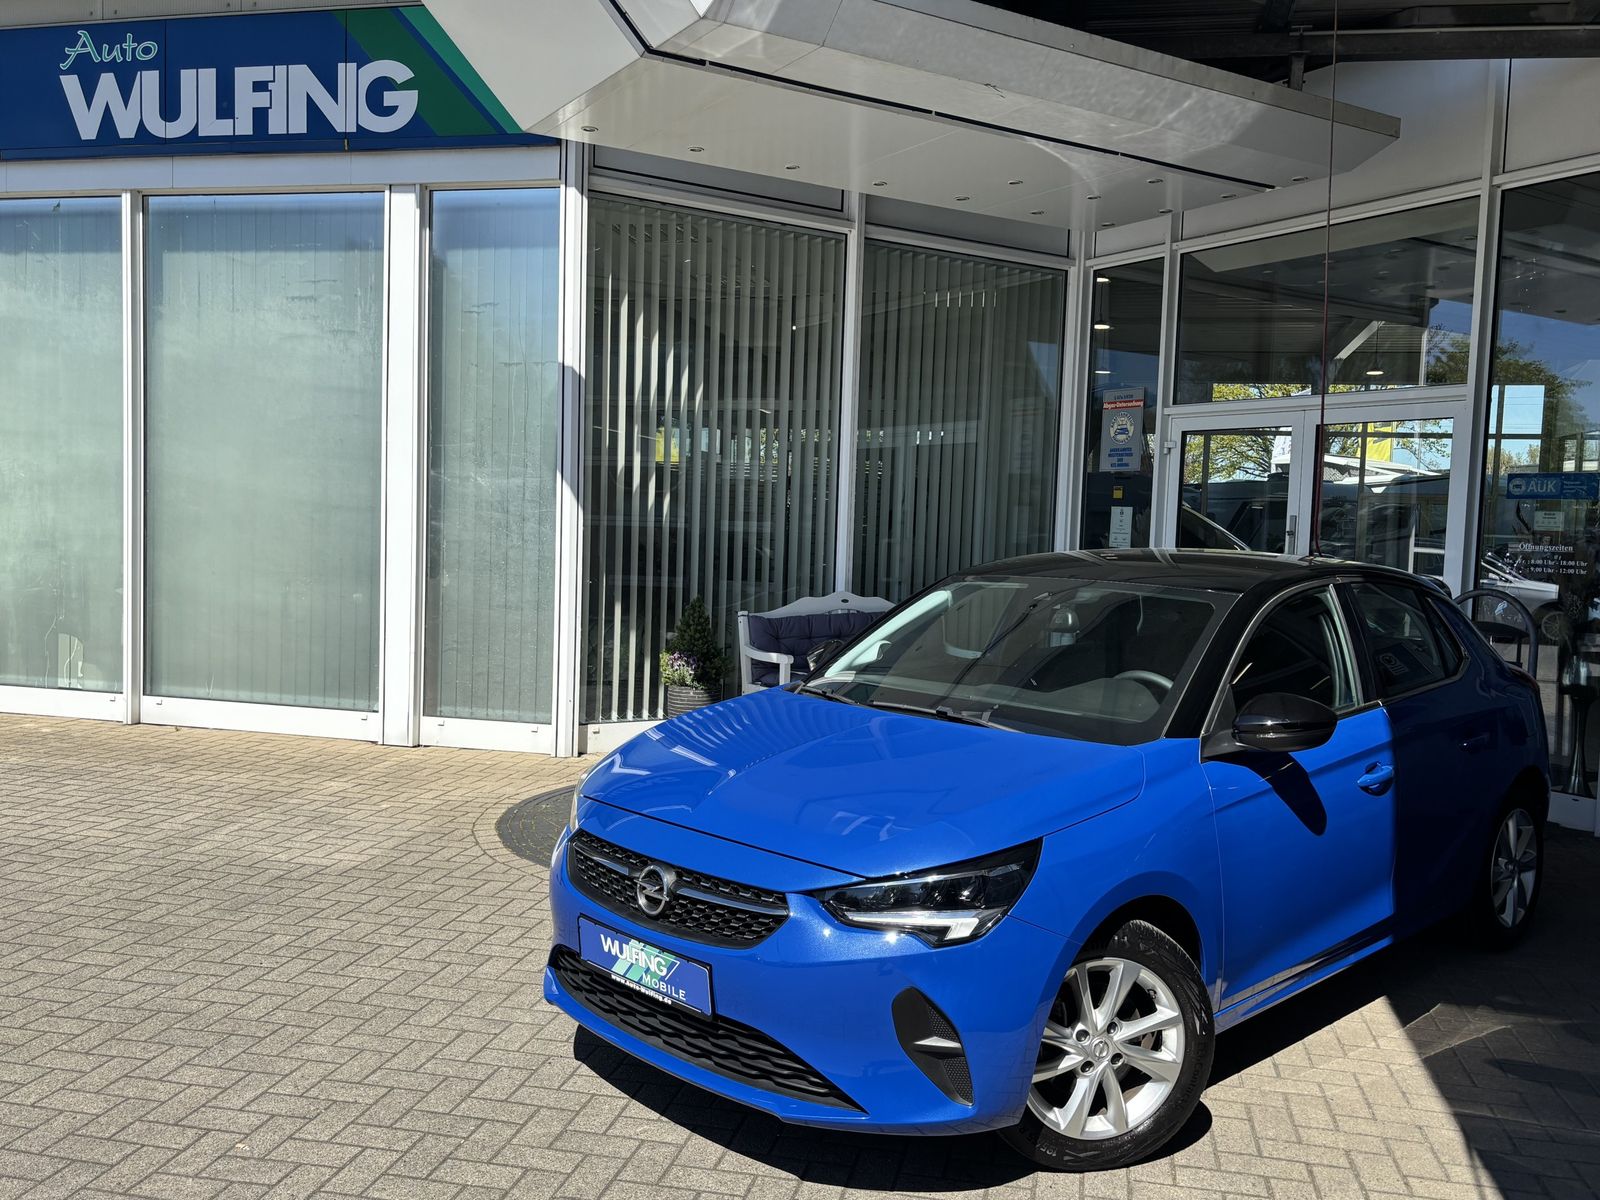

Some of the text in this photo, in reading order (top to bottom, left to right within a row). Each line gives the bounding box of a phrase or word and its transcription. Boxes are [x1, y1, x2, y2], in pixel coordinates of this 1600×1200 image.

[59, 30, 158, 70] Auto
[59, 59, 419, 141] WULFING
[1518, 542, 1573, 552] Öffnungszeiten
[600, 934, 667, 977] WULFING
[642, 972, 686, 1000] MOBILE
